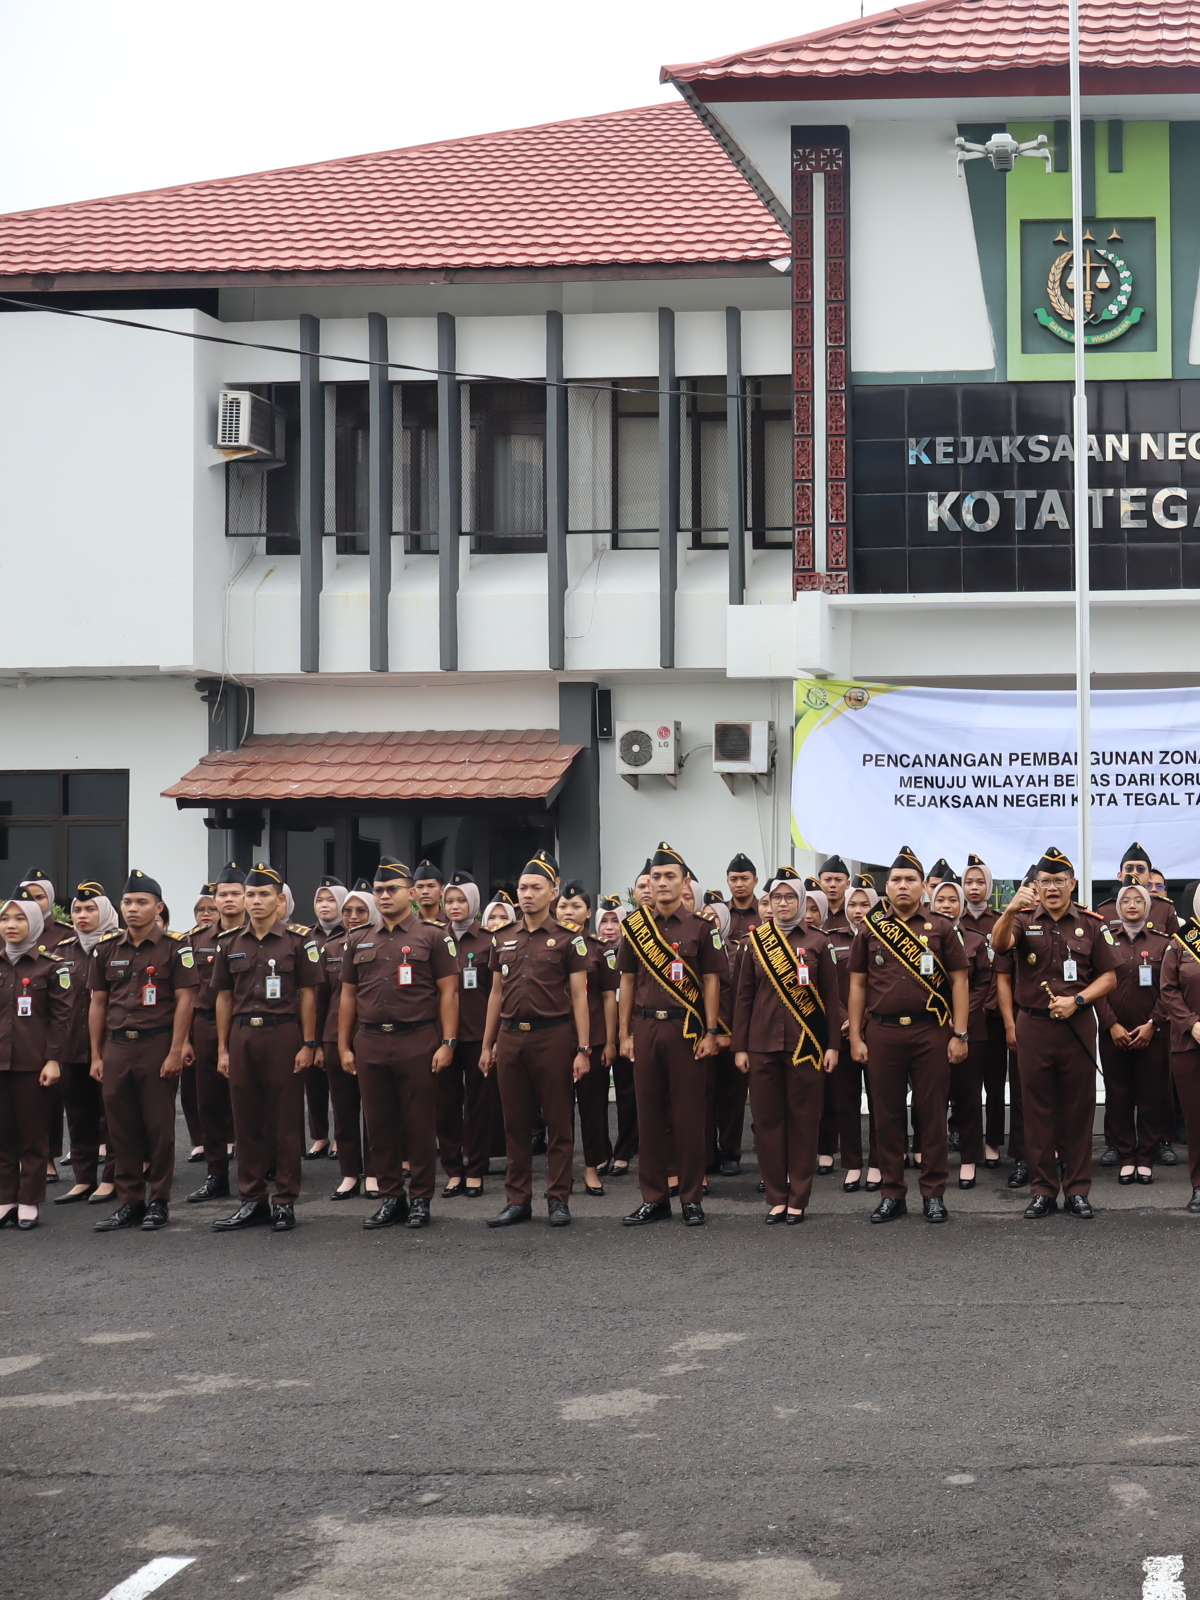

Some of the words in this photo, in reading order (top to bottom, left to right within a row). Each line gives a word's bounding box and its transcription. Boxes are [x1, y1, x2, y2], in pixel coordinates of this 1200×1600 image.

[1048, 321, 1068, 338] SATYA
[1091, 320, 1131, 343] WICAKSANA
[908, 434, 1130, 465] KEJAKSAAN
[927, 488, 1071, 533] KOTA
[862, 753, 1002, 768] PENCANANGAN
[1008, 751, 1153, 767] PEMBAGUNAN
[899, 775, 967, 789] MENUJU
[971, 774, 1049, 789] WILAYAH
[1054, 773, 1111, 787] BEAS
[1115, 773, 1155, 787] DARI
[894, 794, 998, 809] KEJAKSAAN
[1003, 793, 1066, 808] NEGERI
[1071, 793, 1118, 807] KTA
[1123, 792, 1180, 806] TEGAL
[877, 920, 904, 944] AGEN
[634, 925, 669, 969] PELAYANAN
[761, 933, 793, 976] PELAYANAN
